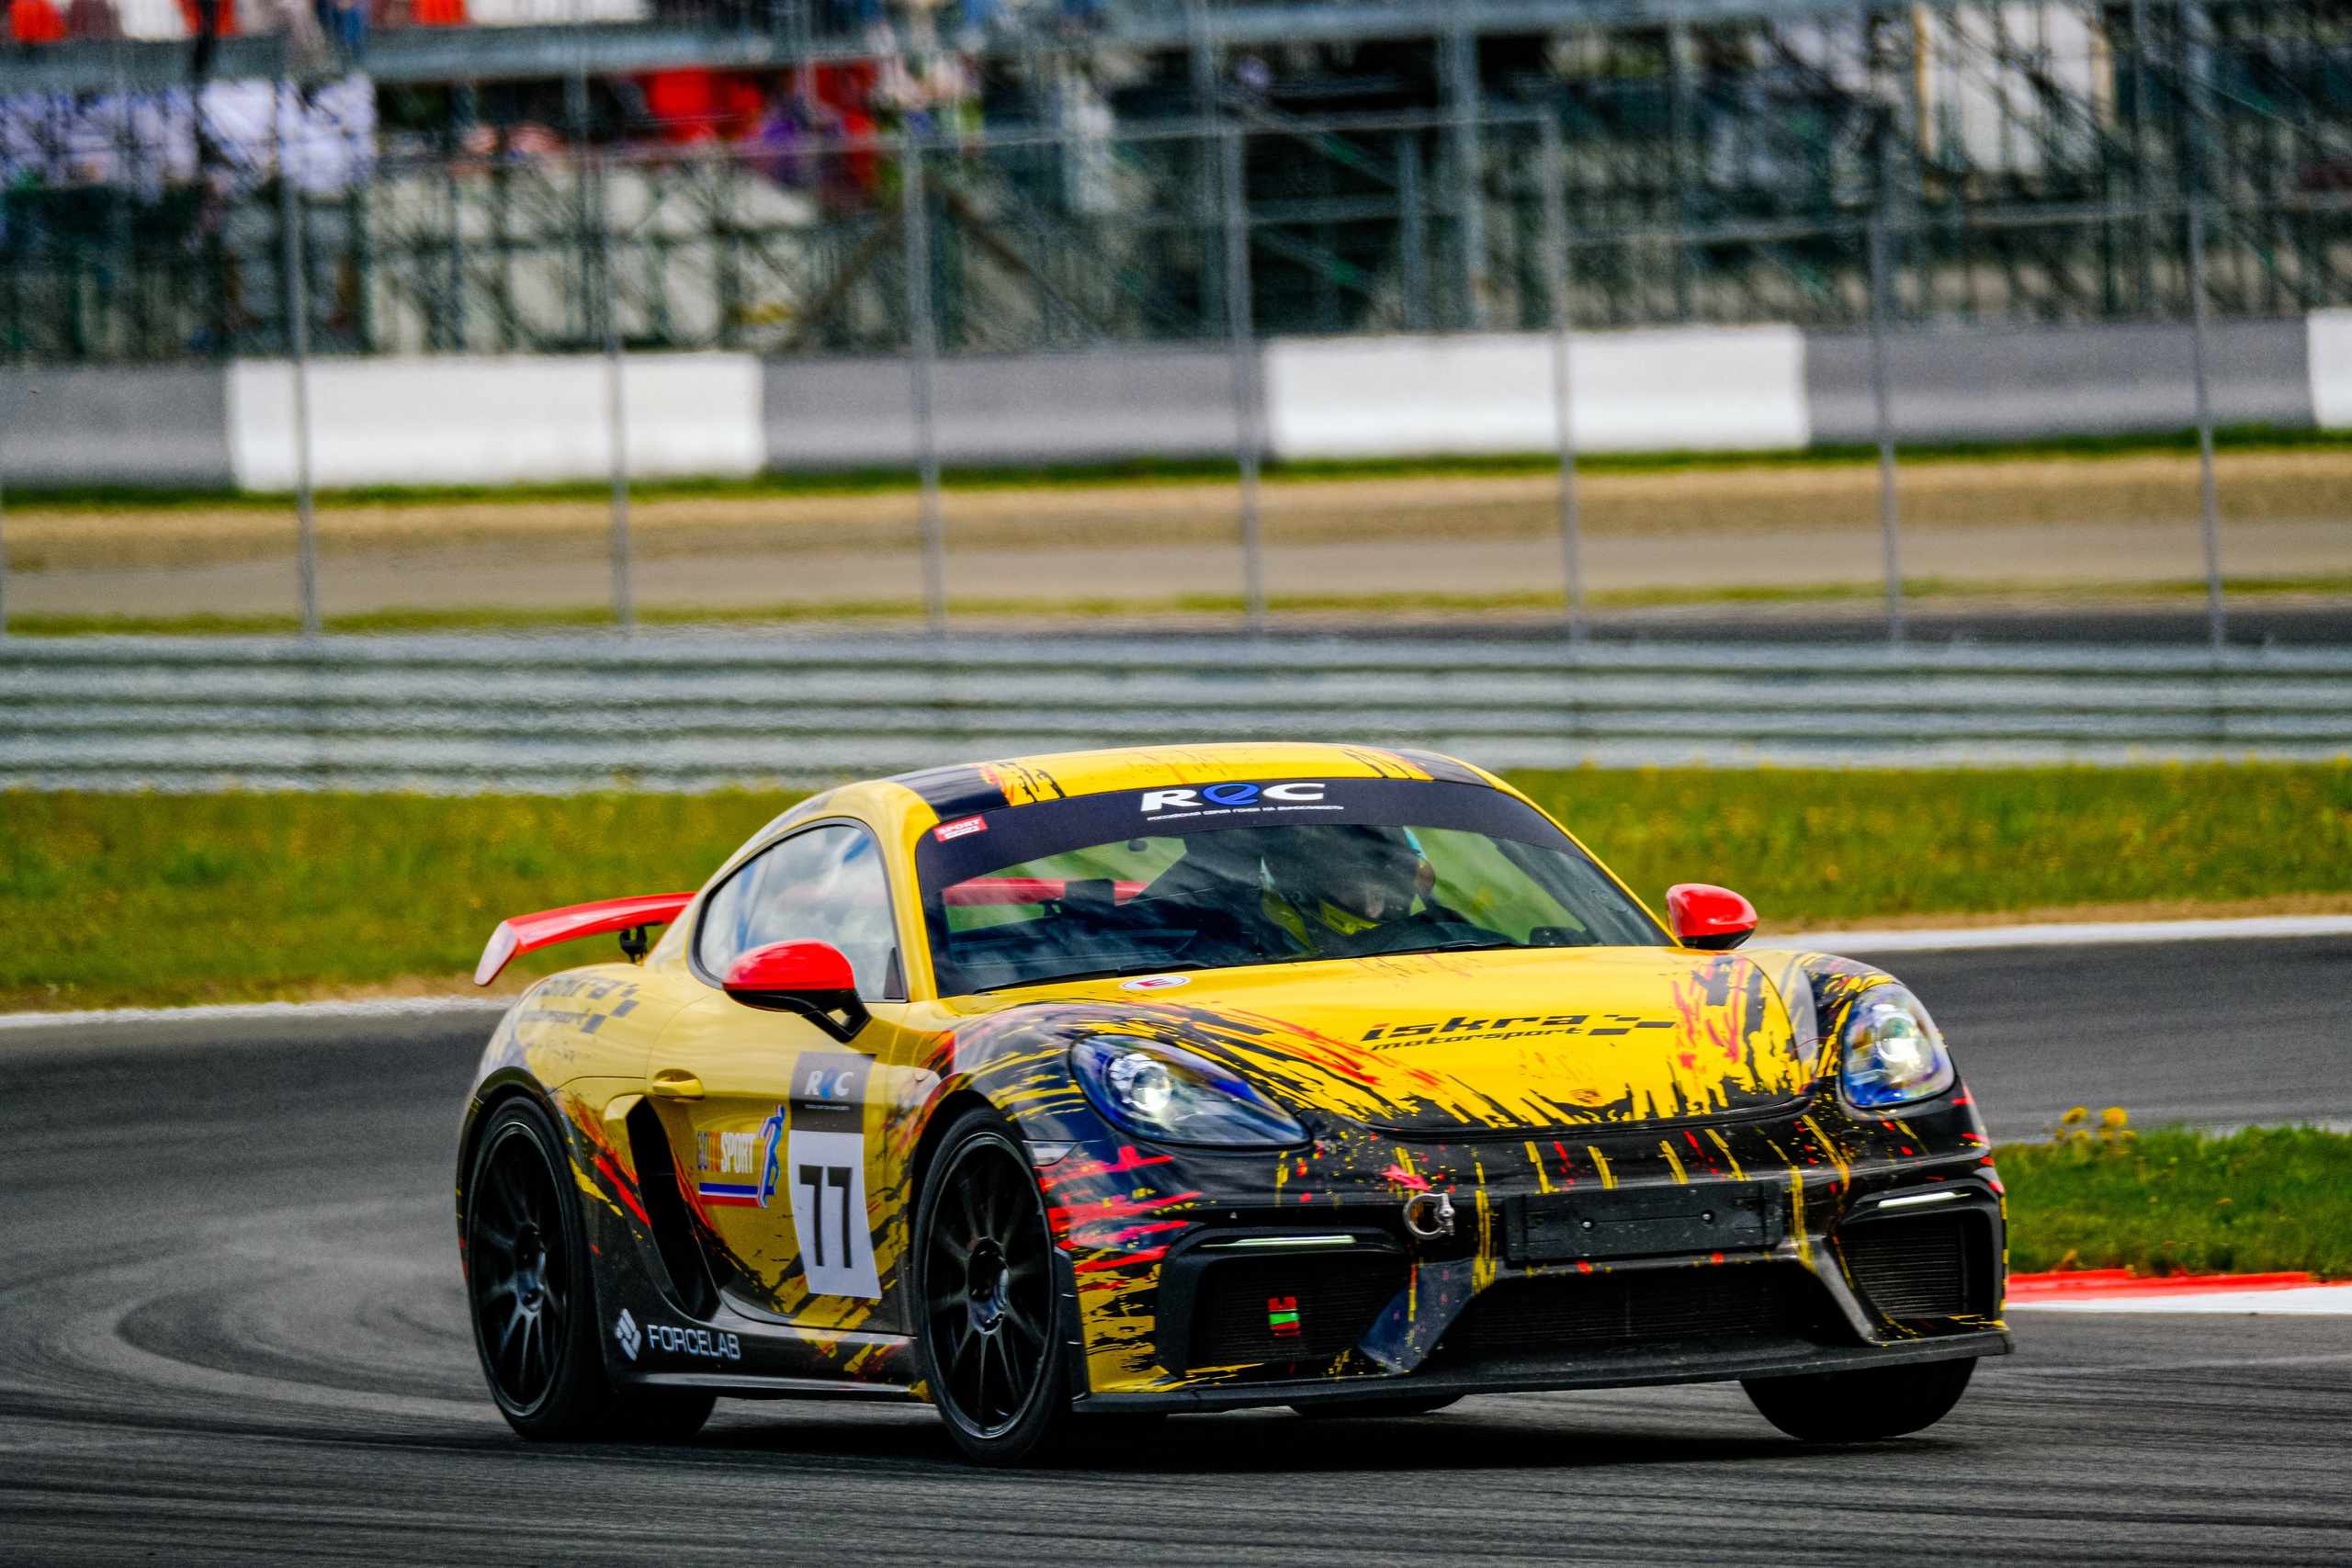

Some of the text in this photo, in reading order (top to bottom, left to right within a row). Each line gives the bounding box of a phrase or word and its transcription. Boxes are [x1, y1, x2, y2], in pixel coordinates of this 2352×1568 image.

[938, 818, 981, 835] SPORT
[1361, 1014, 1591, 1042] iskra
[1371, 1026, 1585, 1052] motorsport
[799, 1164, 854, 1269] 77
[647, 1324, 741, 1360] FORCELAB
